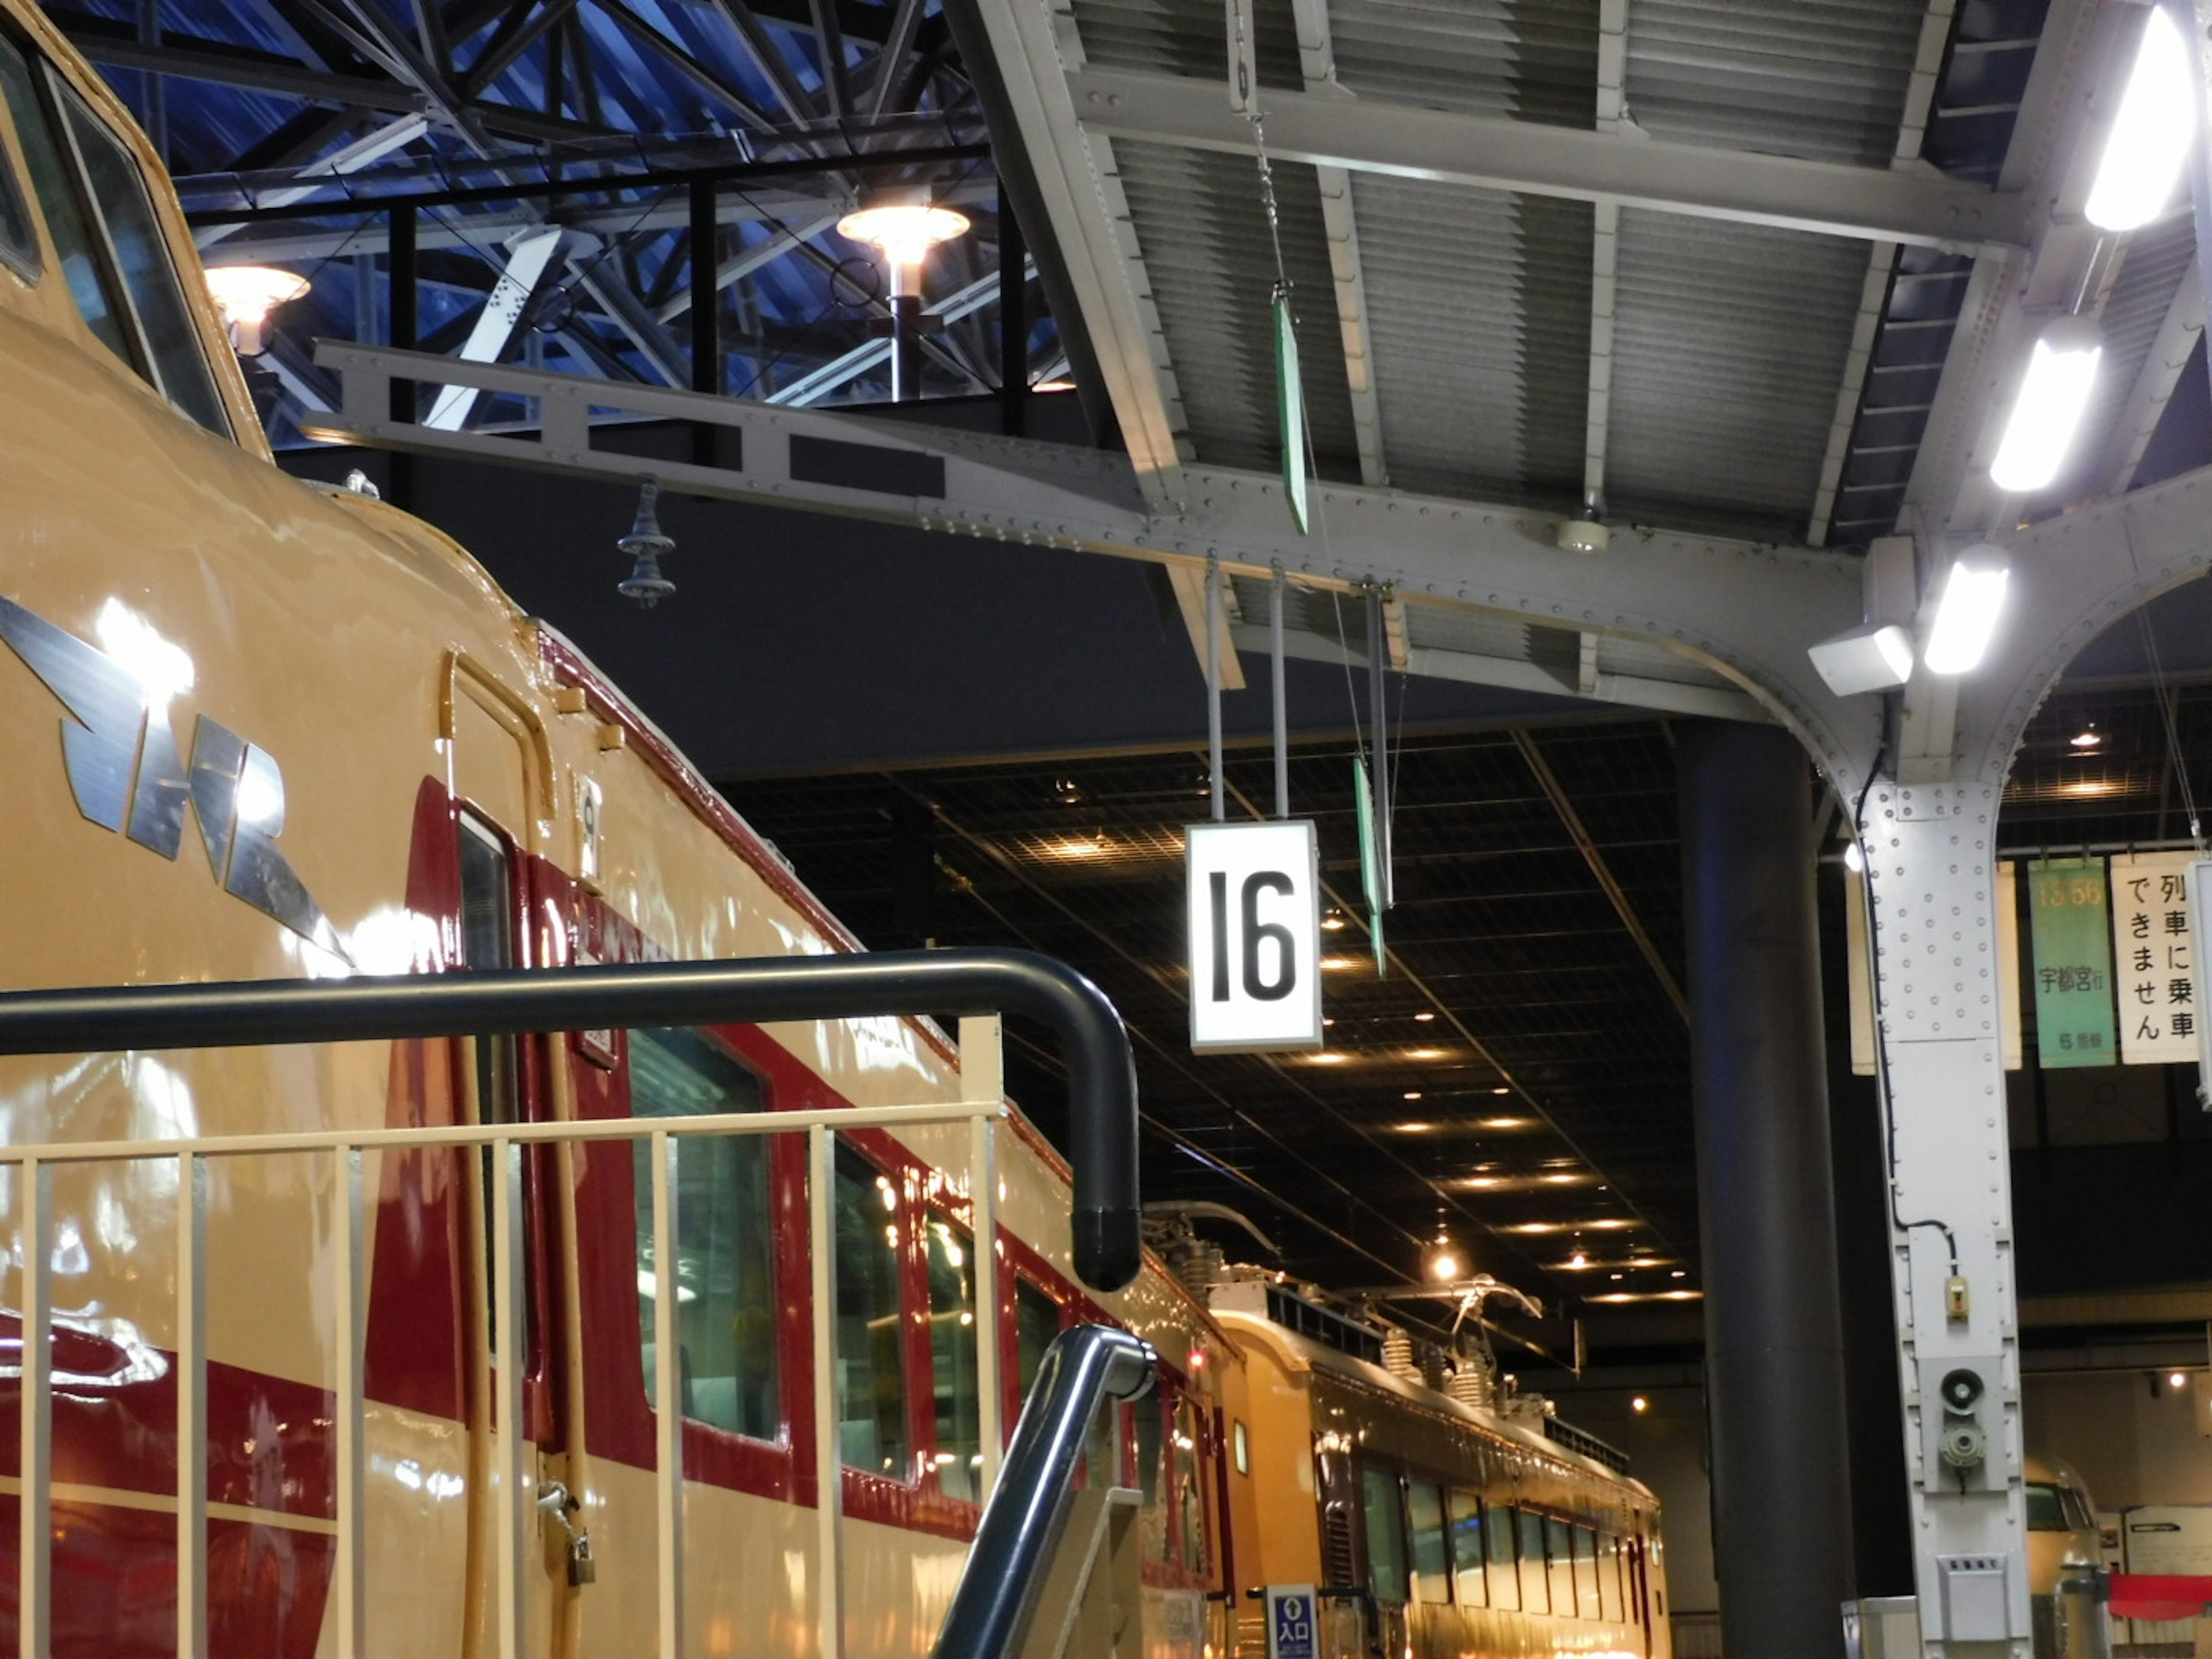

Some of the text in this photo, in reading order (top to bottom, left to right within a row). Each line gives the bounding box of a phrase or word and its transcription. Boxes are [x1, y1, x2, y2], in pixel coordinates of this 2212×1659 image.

[1209, 871, 1296, 1002] 16
[2127, 877, 2159, 1040] できません
[2160, 874, 2195, 1039] 列車に乗車
[1279, 1622, 1308, 1642] 入口
